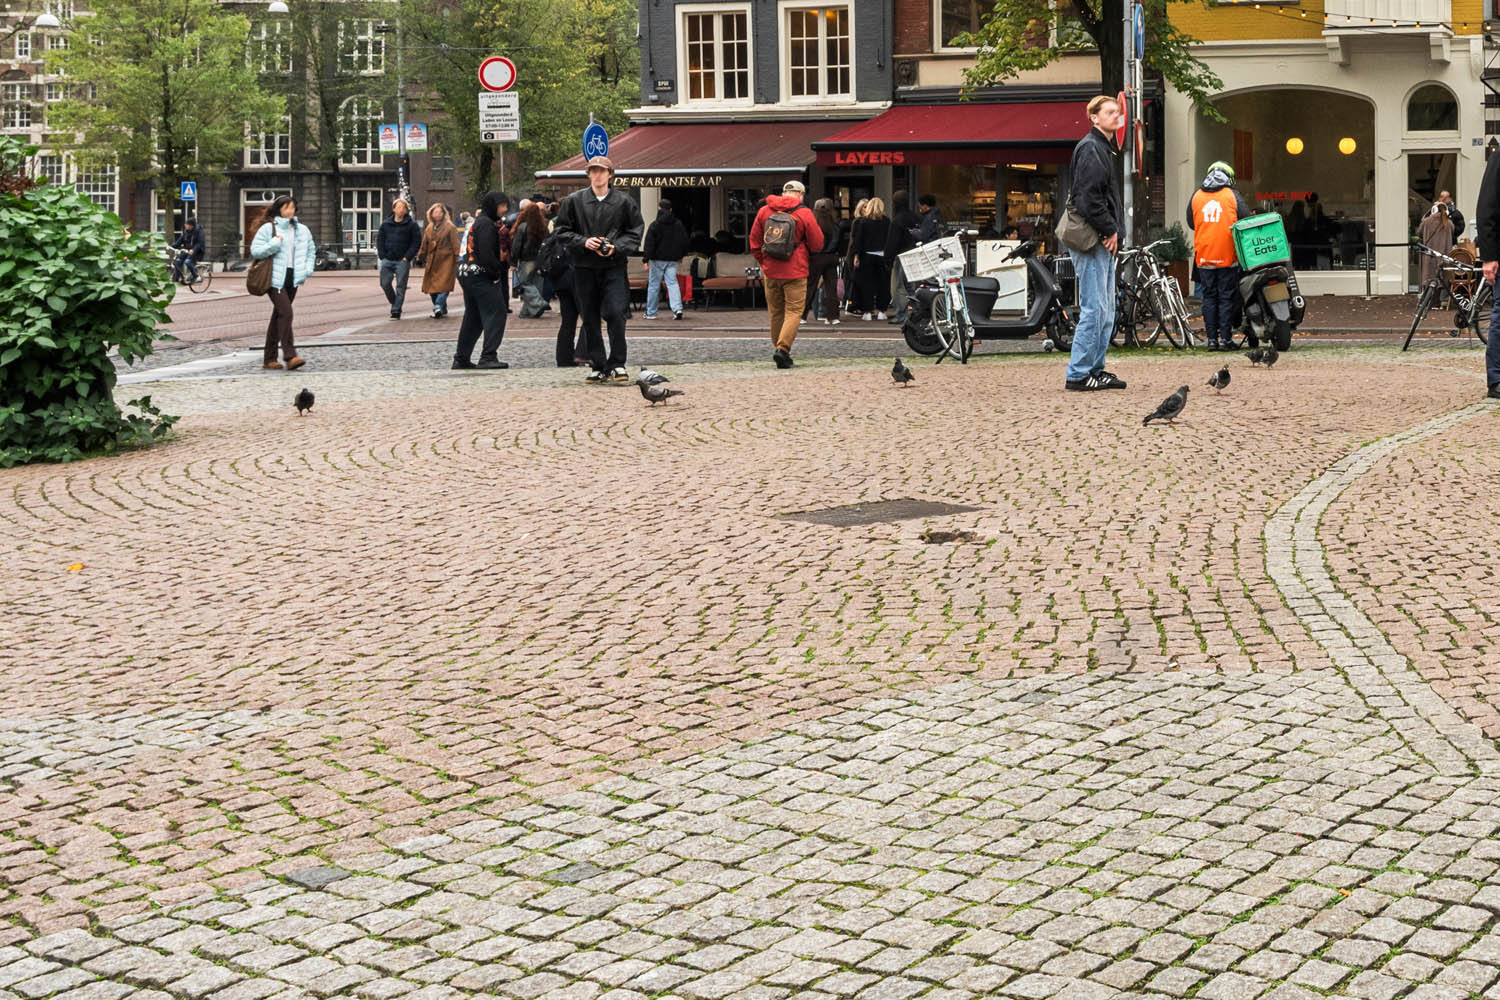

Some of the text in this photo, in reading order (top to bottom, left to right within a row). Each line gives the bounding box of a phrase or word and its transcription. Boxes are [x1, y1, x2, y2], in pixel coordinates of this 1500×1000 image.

[835, 151, 905, 164] LAYERS
[613, 175, 722, 187] DE BRABANTSE AAP
[1251, 236, 1275, 247] Uber
[1254, 244, 1278, 257] Eats
